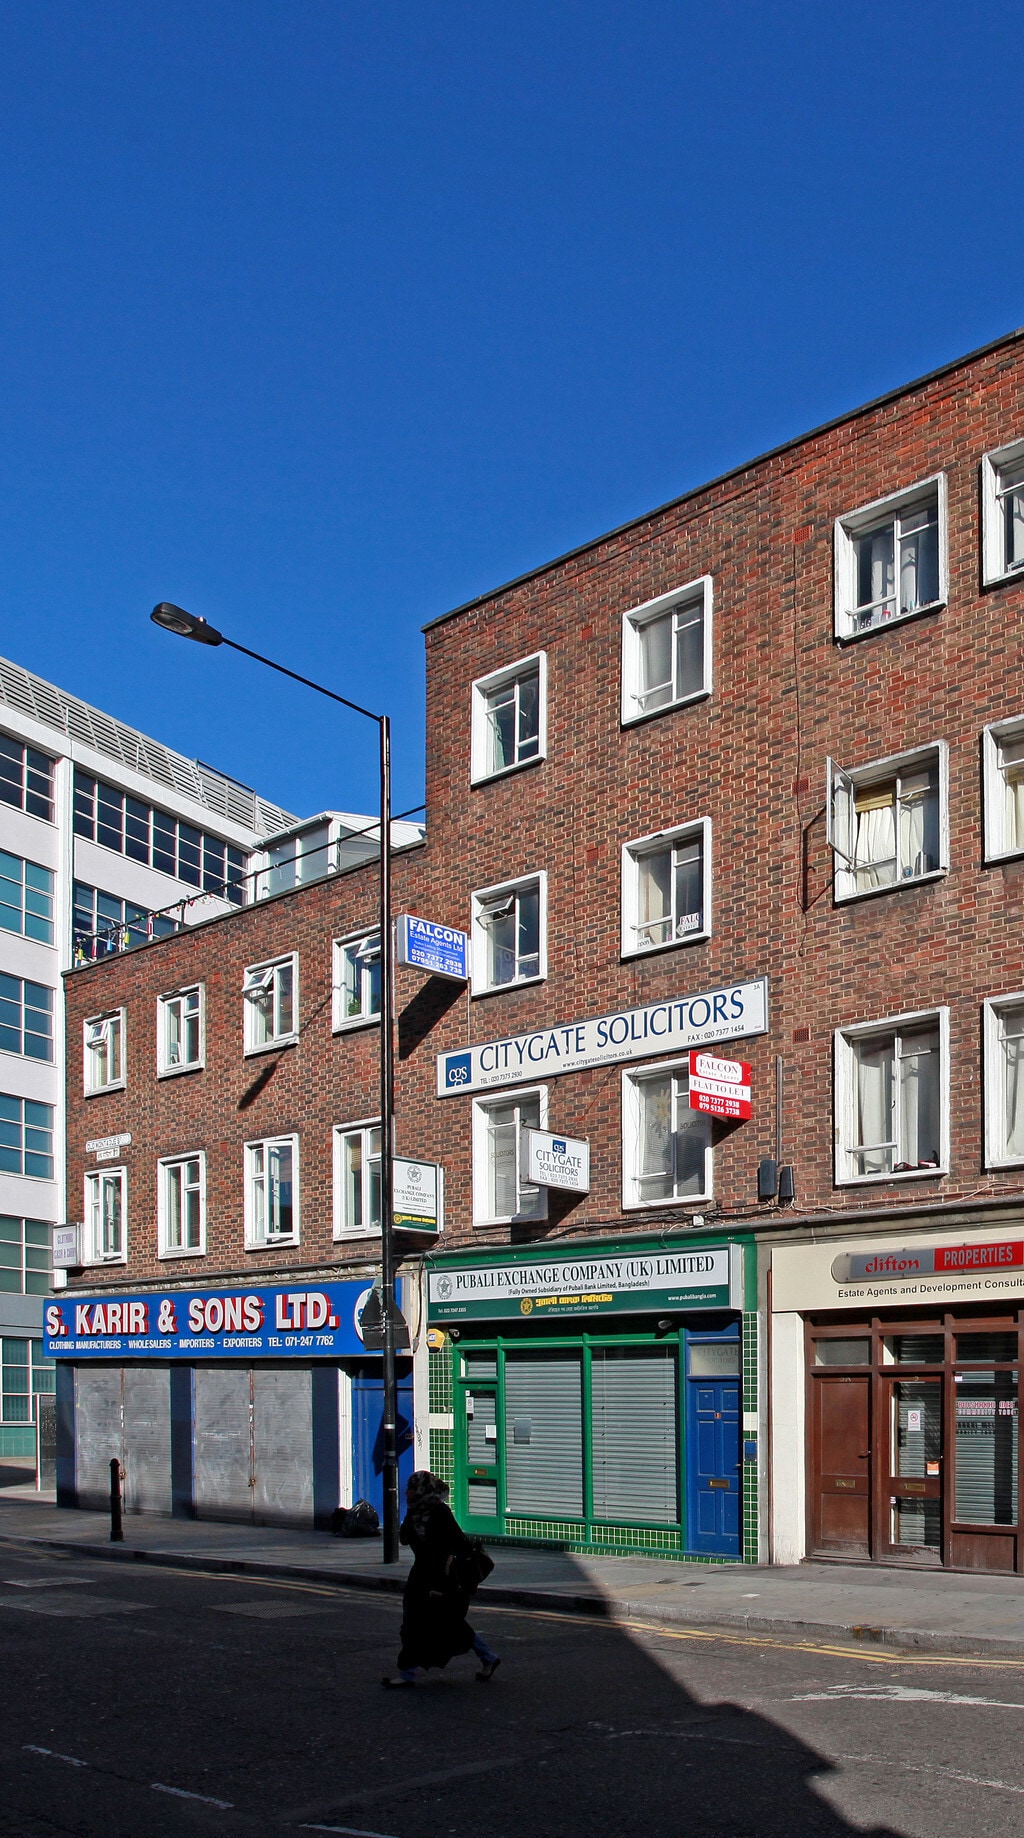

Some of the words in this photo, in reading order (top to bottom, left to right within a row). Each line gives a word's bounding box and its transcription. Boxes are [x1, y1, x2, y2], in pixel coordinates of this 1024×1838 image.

[409, 918, 463, 946] FALCON
[409, 930, 430, 943] Estate
[430, 937, 453, 949] Agents
[453, 943, 463, 953] Ltd
[411, 948, 425, 957] 020
[426, 953, 443, 963] 7377
[479, 1026, 586, 1072] CITYGATE
[597, 989, 744, 1048] SOLICITORS
[704, 1031, 714, 1039] 020
[716, 1028, 729, 1037] 7377
[730, 1024, 745, 1034] 1454
[699, 1058, 738, 1074] FALCON
[448, 1066, 468, 1087] cgs
[693, 1079, 714, 1091] FLAT
[715, 1083, 727, 1093] TO
[729, 1086, 746, 1097] LET
[698, 1094, 709, 1102] 020
[710, 1097, 724, 1105] 7377
[725, 1100, 740, 1108] 2938
[698, 1102, 709, 1110] 079
[710, 1104, 725, 1113] 5126
[725, 1108, 740, 1116] 3738
[536, 1149, 582, 1168] CITYGATE
[539, 1161, 579, 1176] SOLICITORS
[394, 1188, 415, 1196] EXCHANGE
[865, 1255, 920, 1273] clifton
[943, 1245, 1014, 1267] PROPERTIES
[456, 1272, 495, 1289] PUBALI
[497, 1267, 560, 1287] EXCHANGE
[562, 1262, 623, 1282] COMPANY
[626, 1260, 654, 1280] (UK)
[657, 1255, 715, 1275] LIMITED
[521, 1286, 538, 1294] Owned
[538, 1284, 562, 1294] Subsidiary
[562, 1283, 568, 1291] of
[568, 1282, 584, 1291] Pubali
[584, 1281, 596, 1290] Bank
[838, 1289, 865, 1298] Estate
[866, 1287, 898, 1298] Agents
[900, 1285, 917, 1294] and
[919, 1281, 982, 1294] Development
[667, 1293, 717, 1301] www.pubalibangla.com
[46, 1305, 69, 1337] S.
[75, 1301, 149, 1336] KARIR
[157, 1299, 179, 1335] &
[188, 1293, 264, 1334] SONS
[276, 1292, 340, 1331] LTD.
[49, 1340, 74, 1350] CLOTHING
[76, 1340, 121, 1350] MANUFACTURERS
[128, 1339, 172, 1349] WHOLESALERS
[179, 1338, 215, 1349] IMPORTERS
[223, 1338, 262, 1348] EXPORTERS
[268, 1337, 283, 1347] TEL:
[285, 1336, 313, 1347] 071-247
[316, 1335, 334, 1346] 7762
